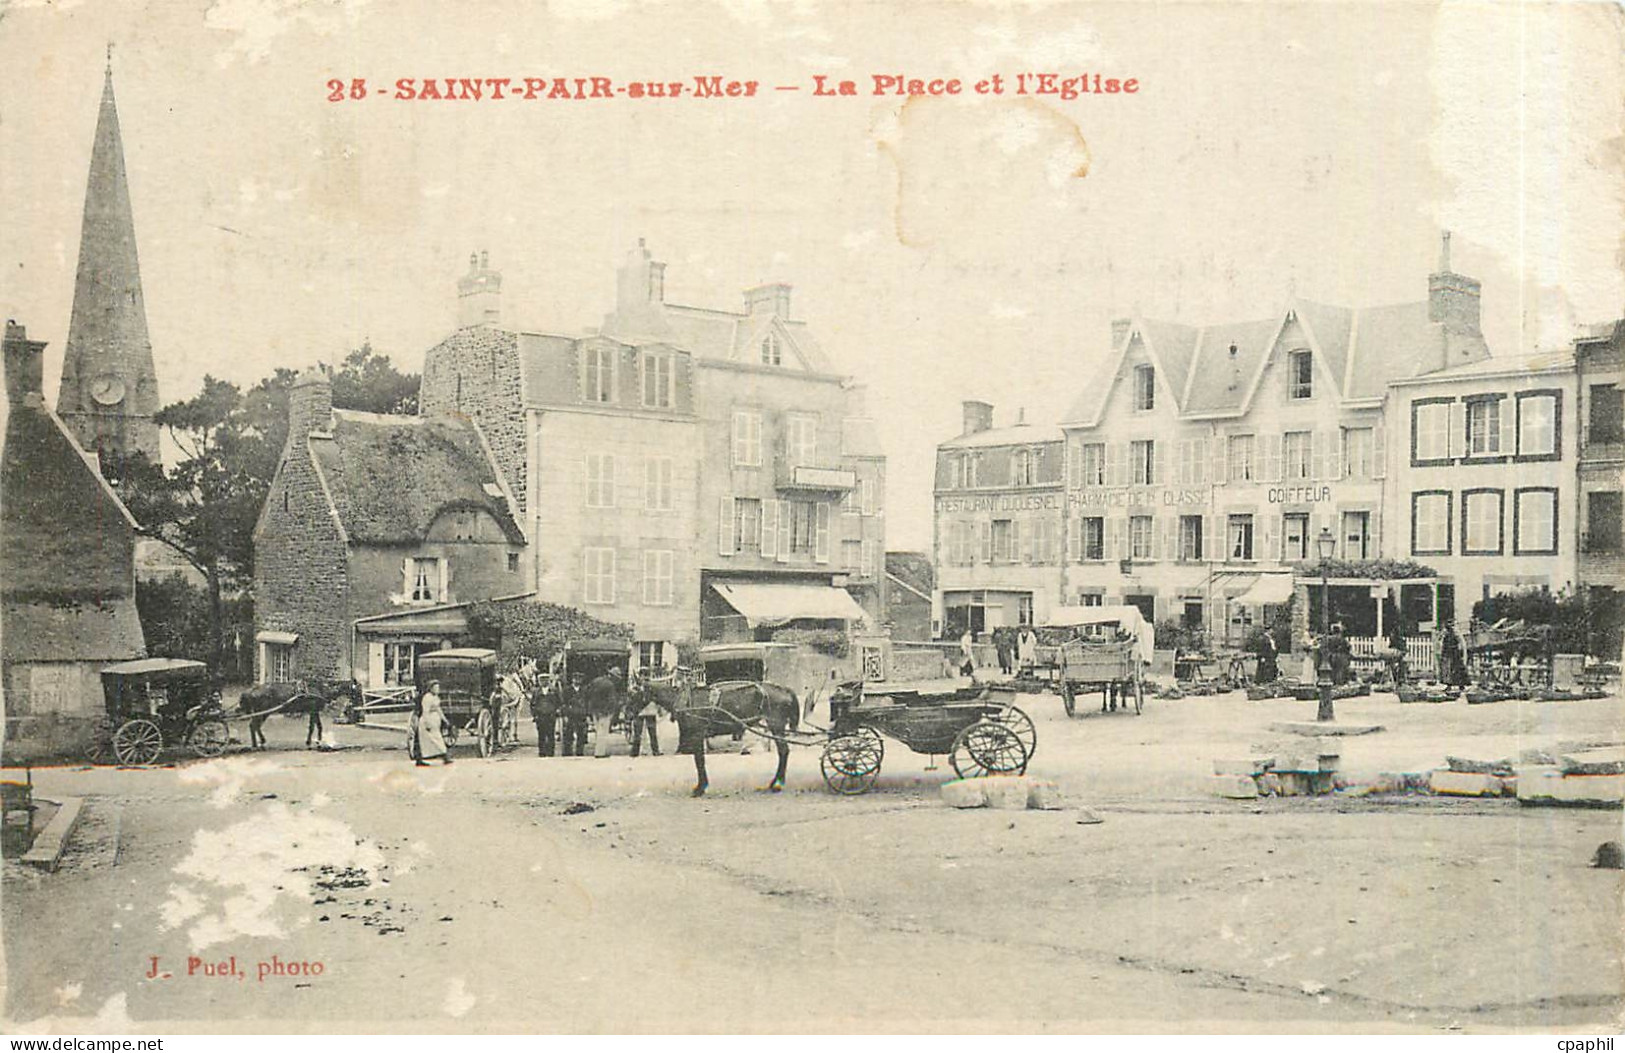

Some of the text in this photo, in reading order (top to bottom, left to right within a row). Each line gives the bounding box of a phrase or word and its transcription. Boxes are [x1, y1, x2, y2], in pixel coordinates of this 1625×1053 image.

[1128, 491, 1143, 507] DE
[1163, 490, 1209, 507] CLASSE
[1268, 486, 1331, 503] COIFFEUR
